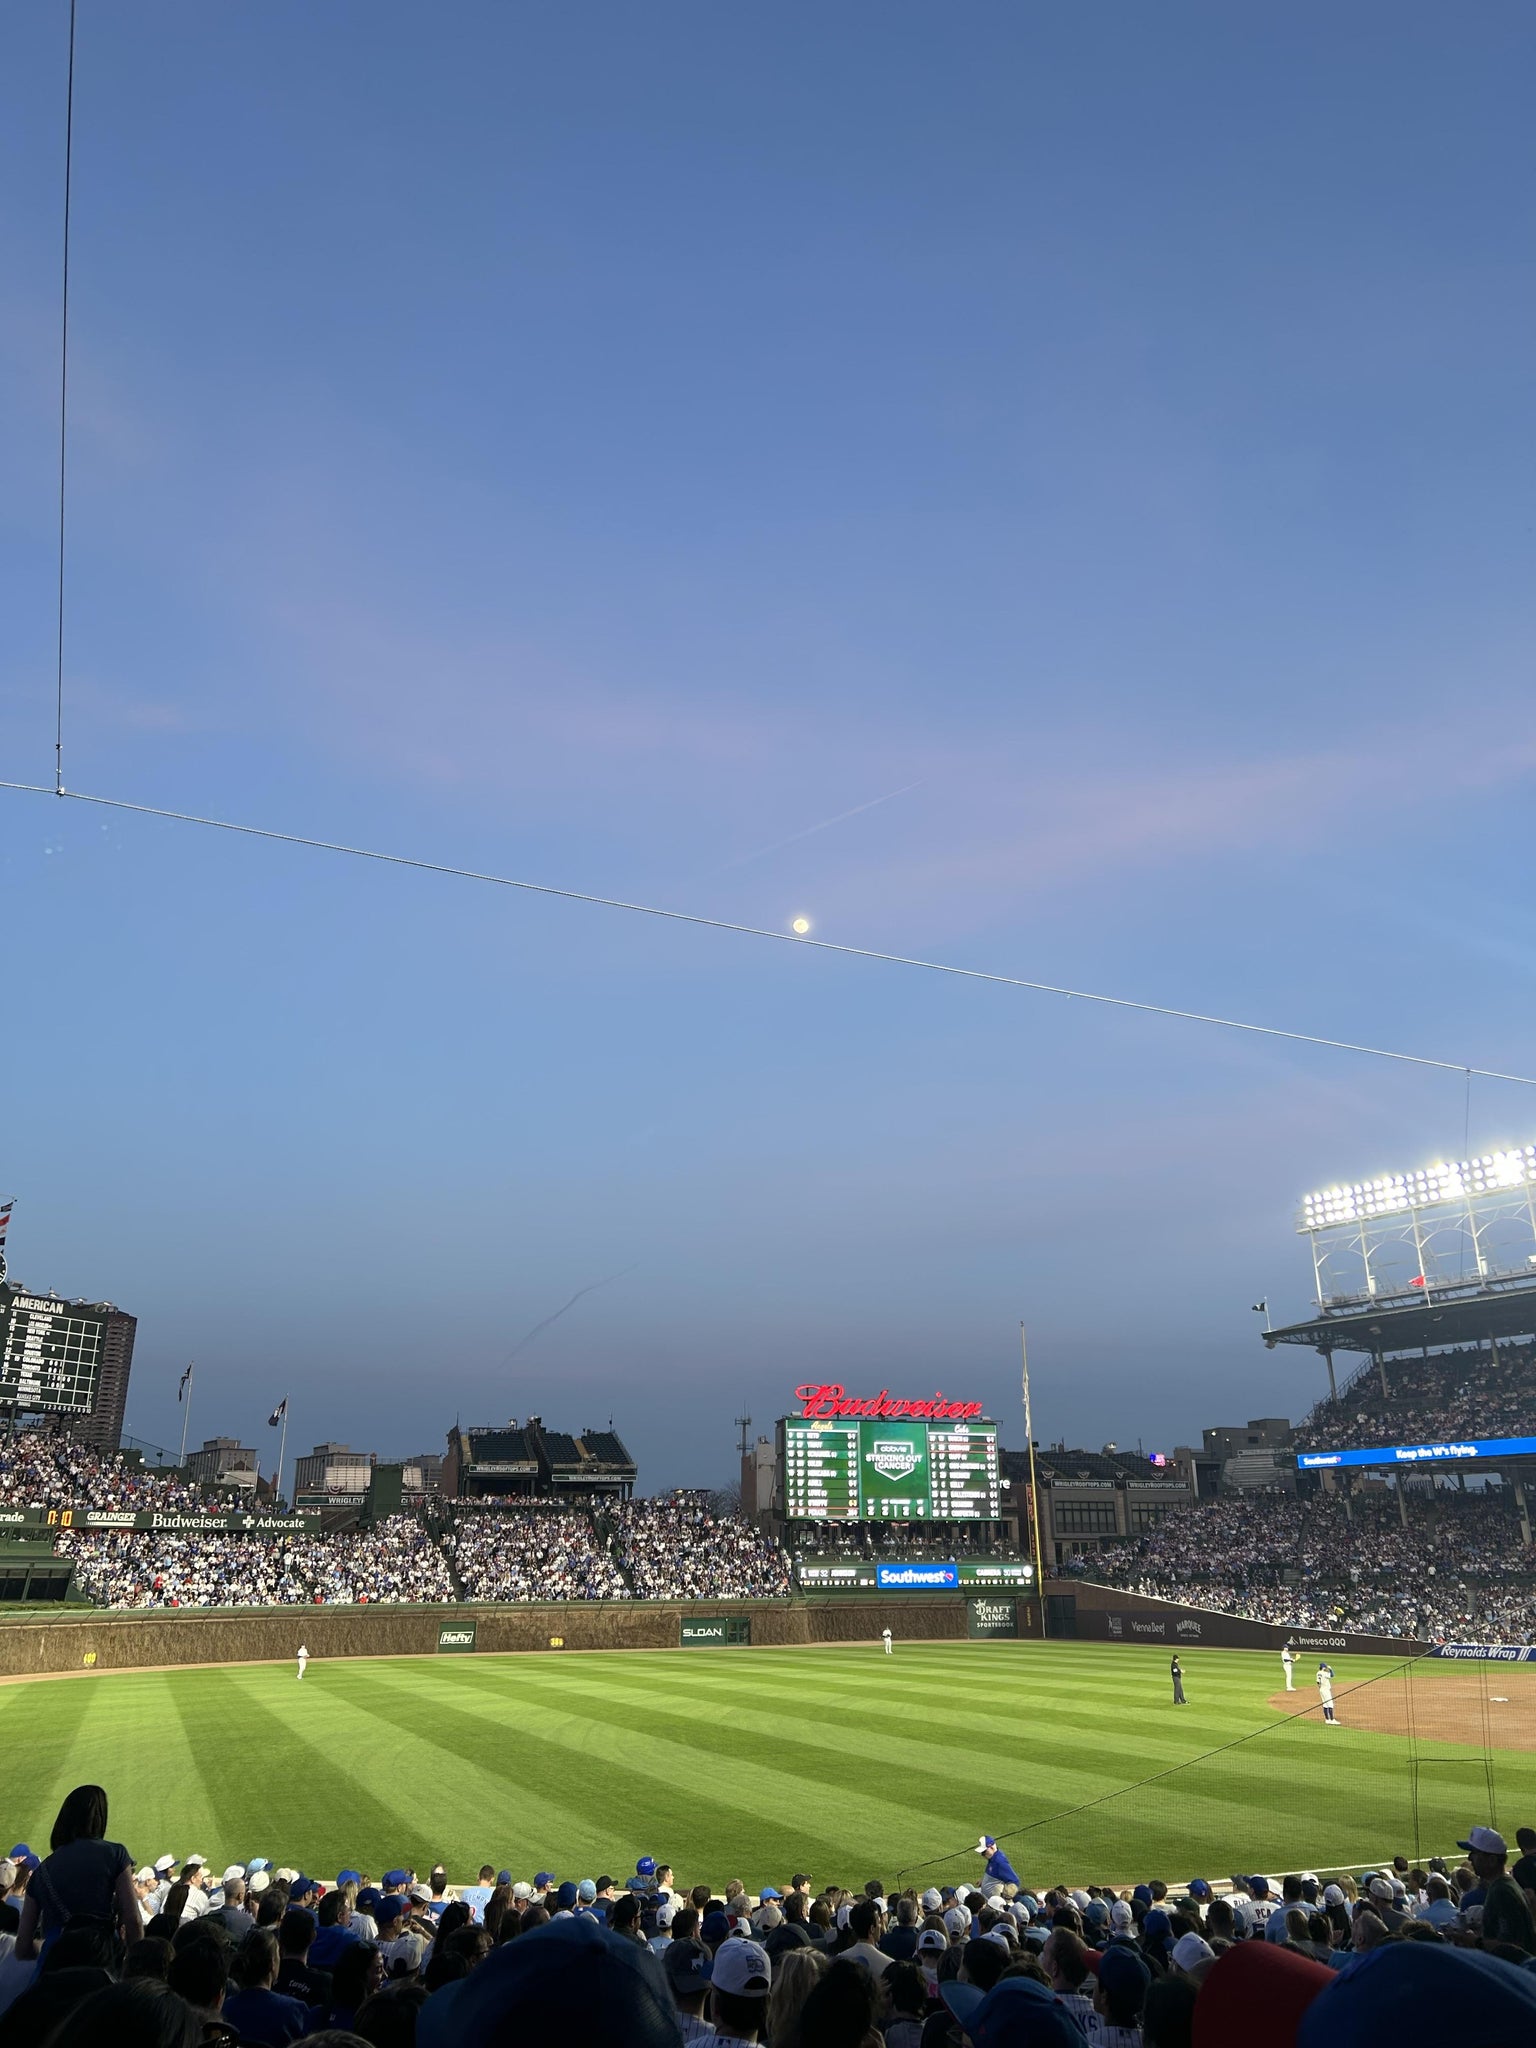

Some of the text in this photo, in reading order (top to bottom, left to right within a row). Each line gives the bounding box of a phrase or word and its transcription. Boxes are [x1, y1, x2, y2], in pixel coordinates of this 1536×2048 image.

[12, 1296, 64, 1314] AMERICAN
[795, 1384, 983, 1419] Budweiser
[865, 1454, 904, 1462] STRIKING
[905, 1455, 923, 1463] OUT
[1396, 1450, 1417, 1460] Keep
[1418, 1448, 1433, 1458] the
[1433, 1446, 1449, 1457] W's
[87, 1511, 136, 1521] GRAINGER
[151, 1513, 226, 1528] Budweiser
[256, 1517, 305, 1528] Advocate
[881, 1569, 945, 1584] Southwest
[976, 1605, 1010, 1615] DRAFT
[980, 1613, 1010, 1621] KINGS
[682, 1628, 722, 1637] SLOAN
[1131, 1620, 1151, 1633] Vienna
[1151, 1622, 1165, 1636] Beef
[1176, 1619, 1202, 1634] MARQUEE
[442, 1632, 471, 1644] Hefty
[1299, 1637, 1346, 1647] Invesco QQQ
[1441, 1645, 1517, 1660] Reynolds Wrap
